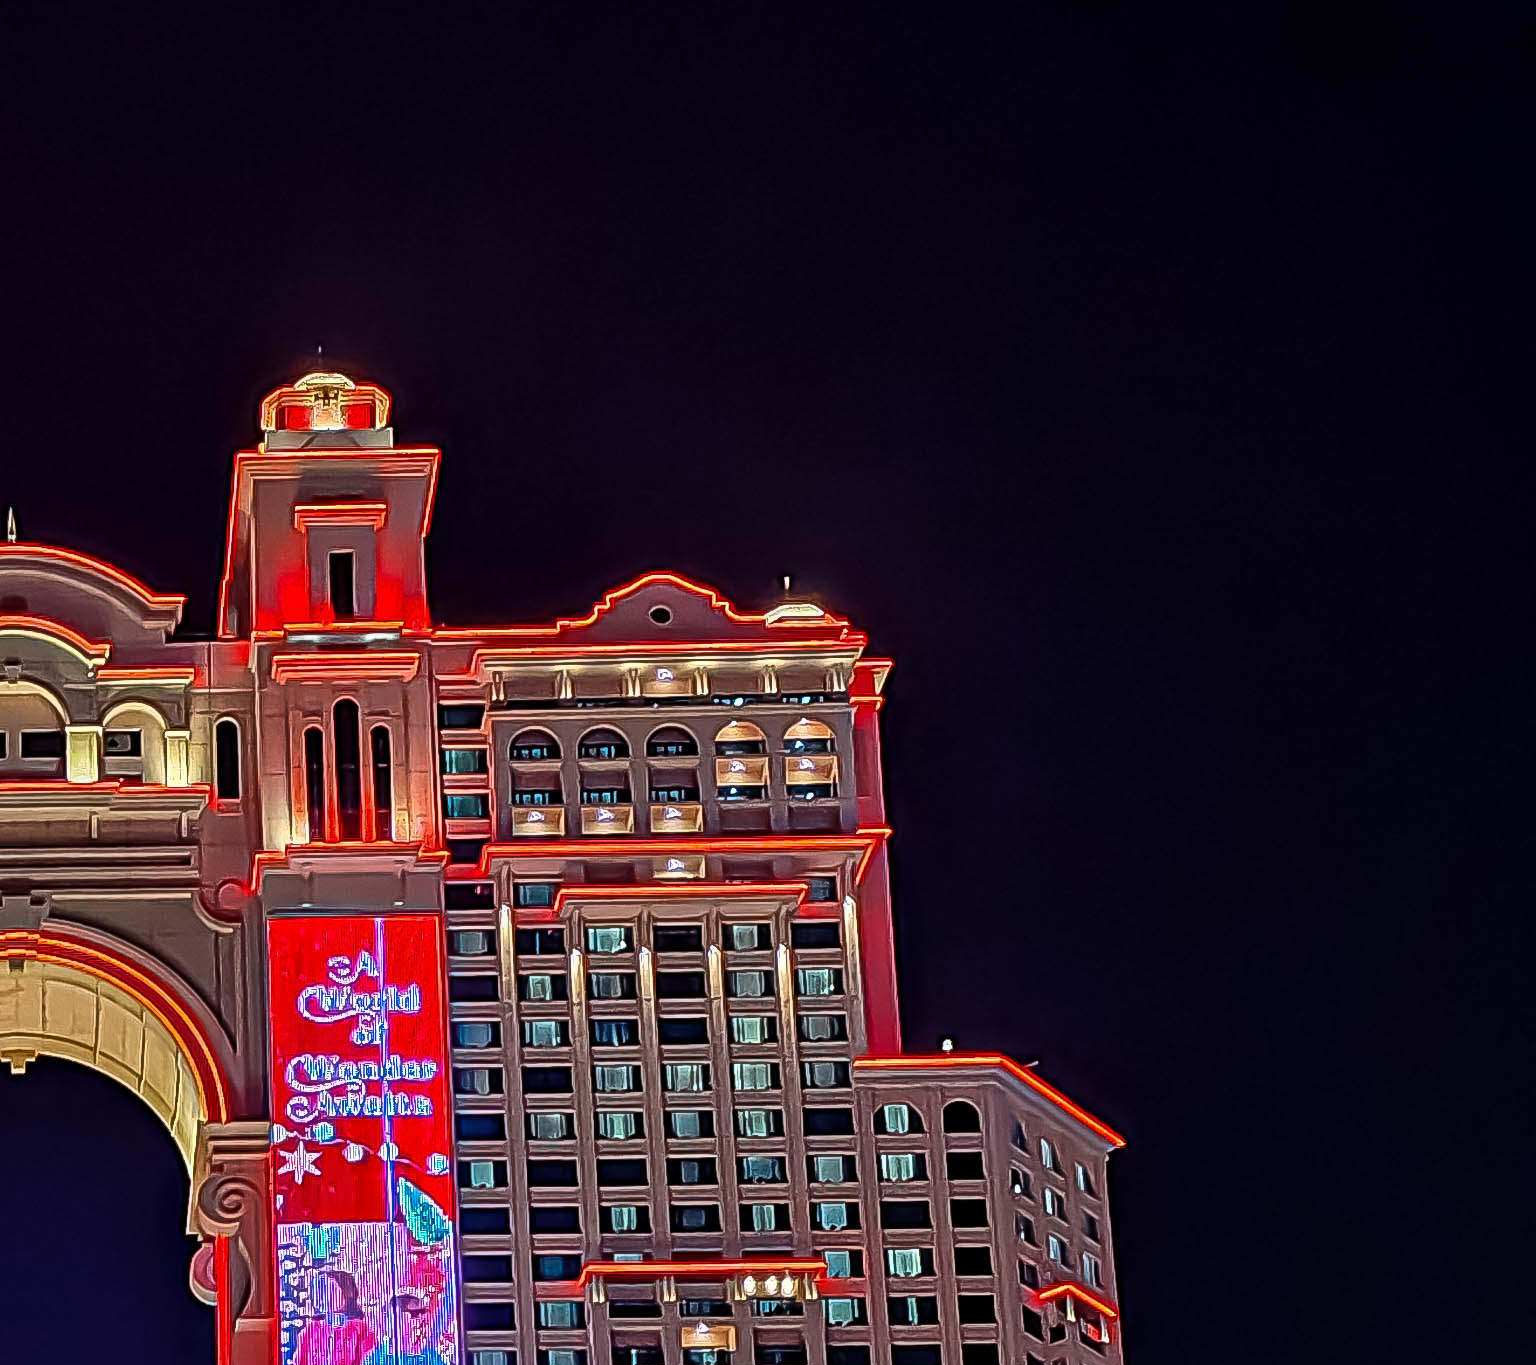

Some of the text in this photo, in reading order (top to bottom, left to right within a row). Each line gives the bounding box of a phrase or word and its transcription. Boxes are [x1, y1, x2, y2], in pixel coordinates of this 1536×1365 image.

[297, 984, 421, 1023] World
[350, 1013, 388, 1045] of
[285, 1053, 437, 1091] Wonder
